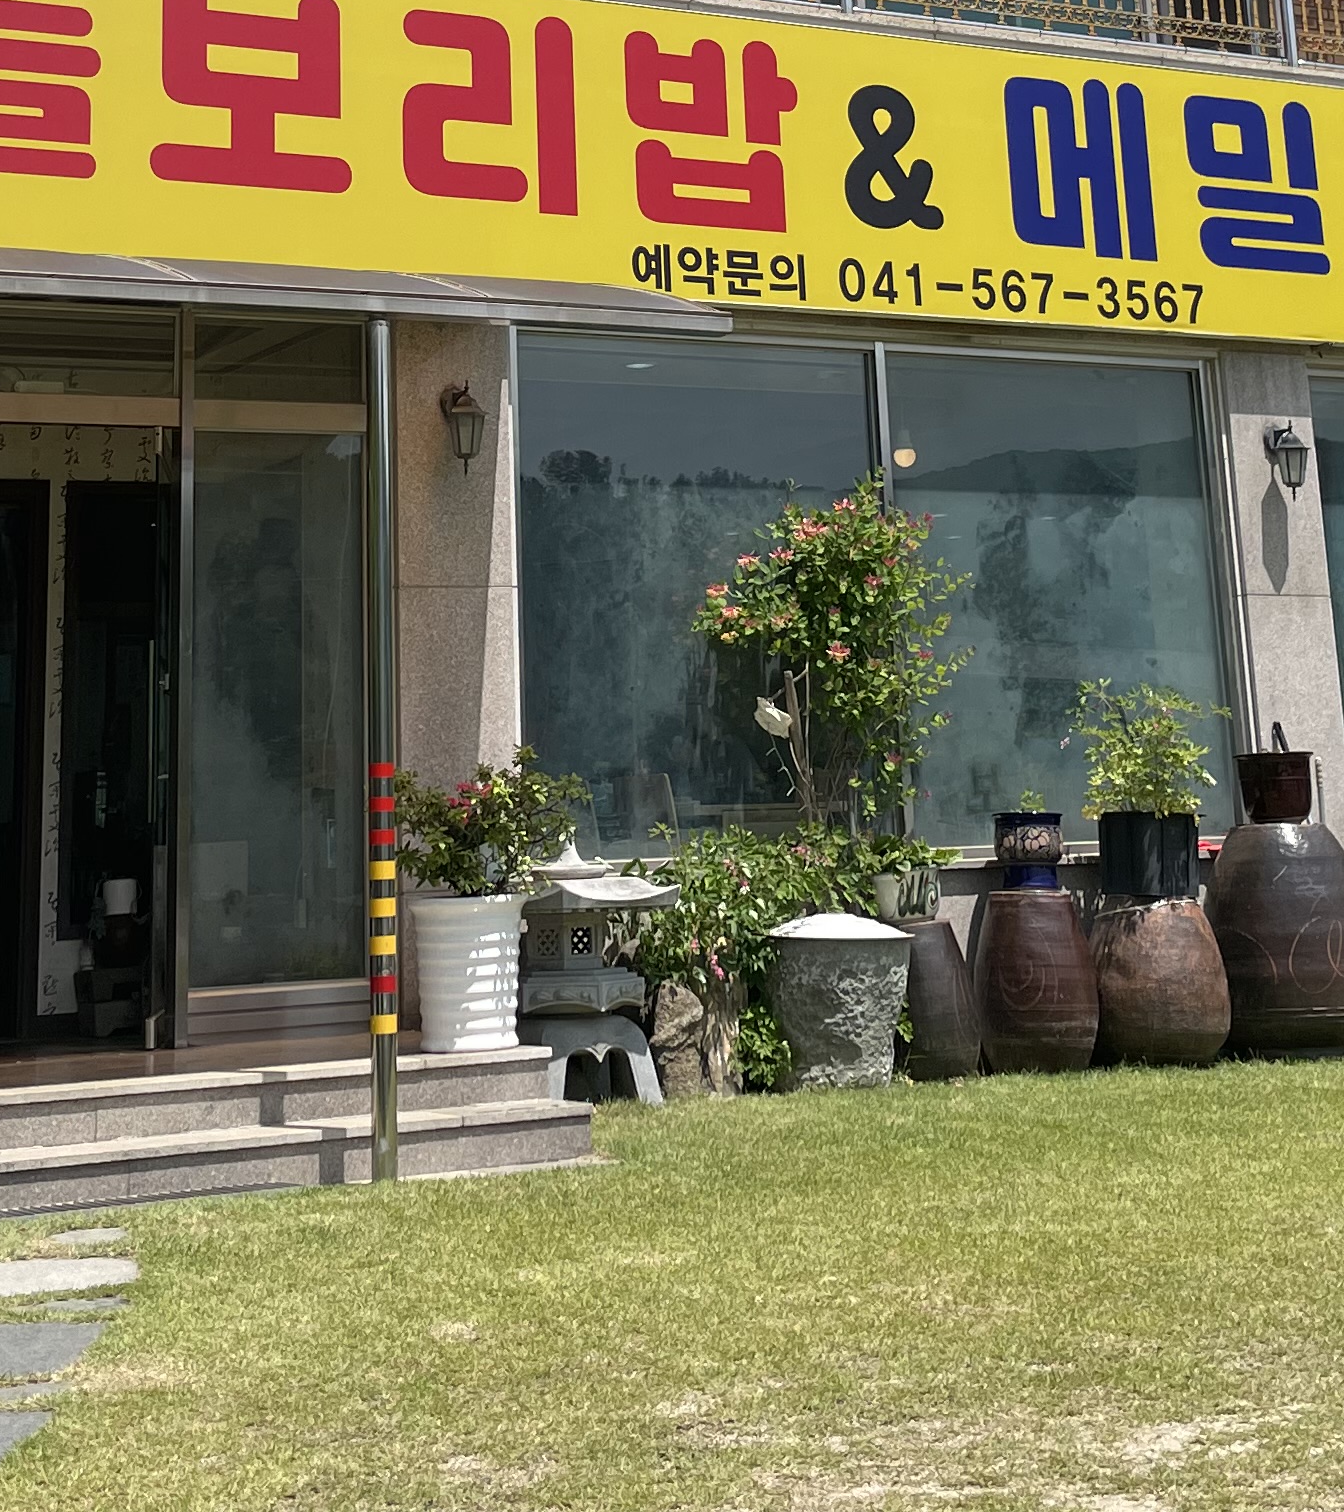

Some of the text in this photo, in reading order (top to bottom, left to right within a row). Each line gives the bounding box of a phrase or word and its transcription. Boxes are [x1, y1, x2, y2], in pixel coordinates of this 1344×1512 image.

[844, 84, 945, 230] &
[631, 244, 1204, 324] 예약문의 041-567-3567
